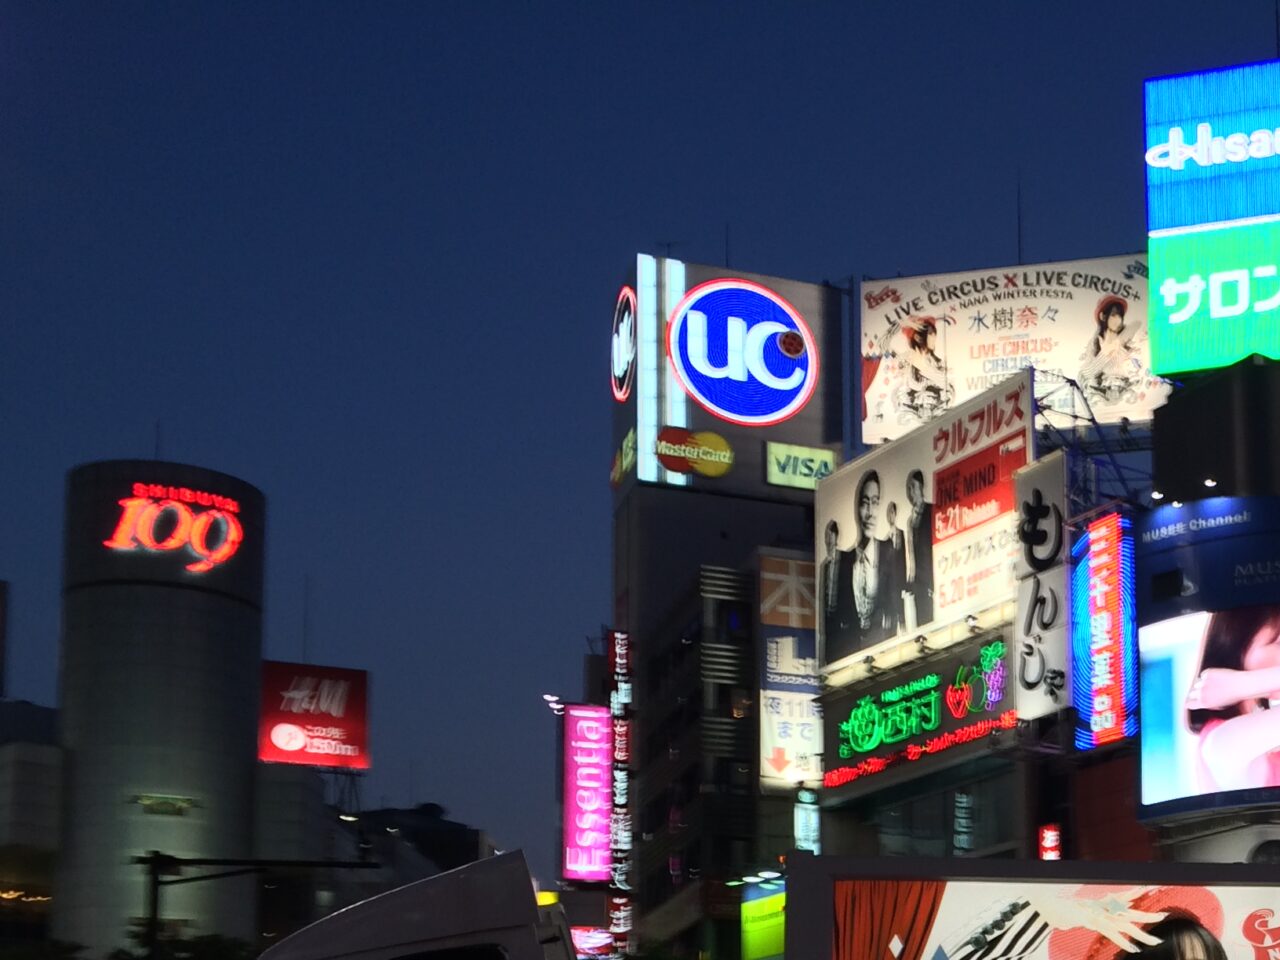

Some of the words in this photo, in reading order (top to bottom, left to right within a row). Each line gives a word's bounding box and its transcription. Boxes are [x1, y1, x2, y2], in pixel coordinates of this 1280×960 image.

[884, 295, 921, 326] LIVE
[927, 274, 1000, 306] CIRCUS
[1022, 270, 1071, 288] LIVE
[959, 294, 989, 310] NANA
[992, 289, 1038, 301] WINTER
[1039, 288, 1074, 301] FESTA
[967, 305, 1061, 333] 水樹奈々
[933, 382, 1027, 464] ウルフルズ
[656, 439, 735, 465] MasterCard
[774, 453, 834, 480] VISA
[133, 483, 240, 513] SHIBUYA
[936, 478, 961, 509] ONE
[963, 463, 996, 497] MIND
[103, 497, 244, 574] 109
[935, 502, 962, 541] 5.21
[1188, 511, 1252, 532] Channel
[761, 557, 817, 627] 本
[938, 574, 966, 609] 5.20
[776, 720, 815, 742] まで
[566, 707, 606, 874] Essential
